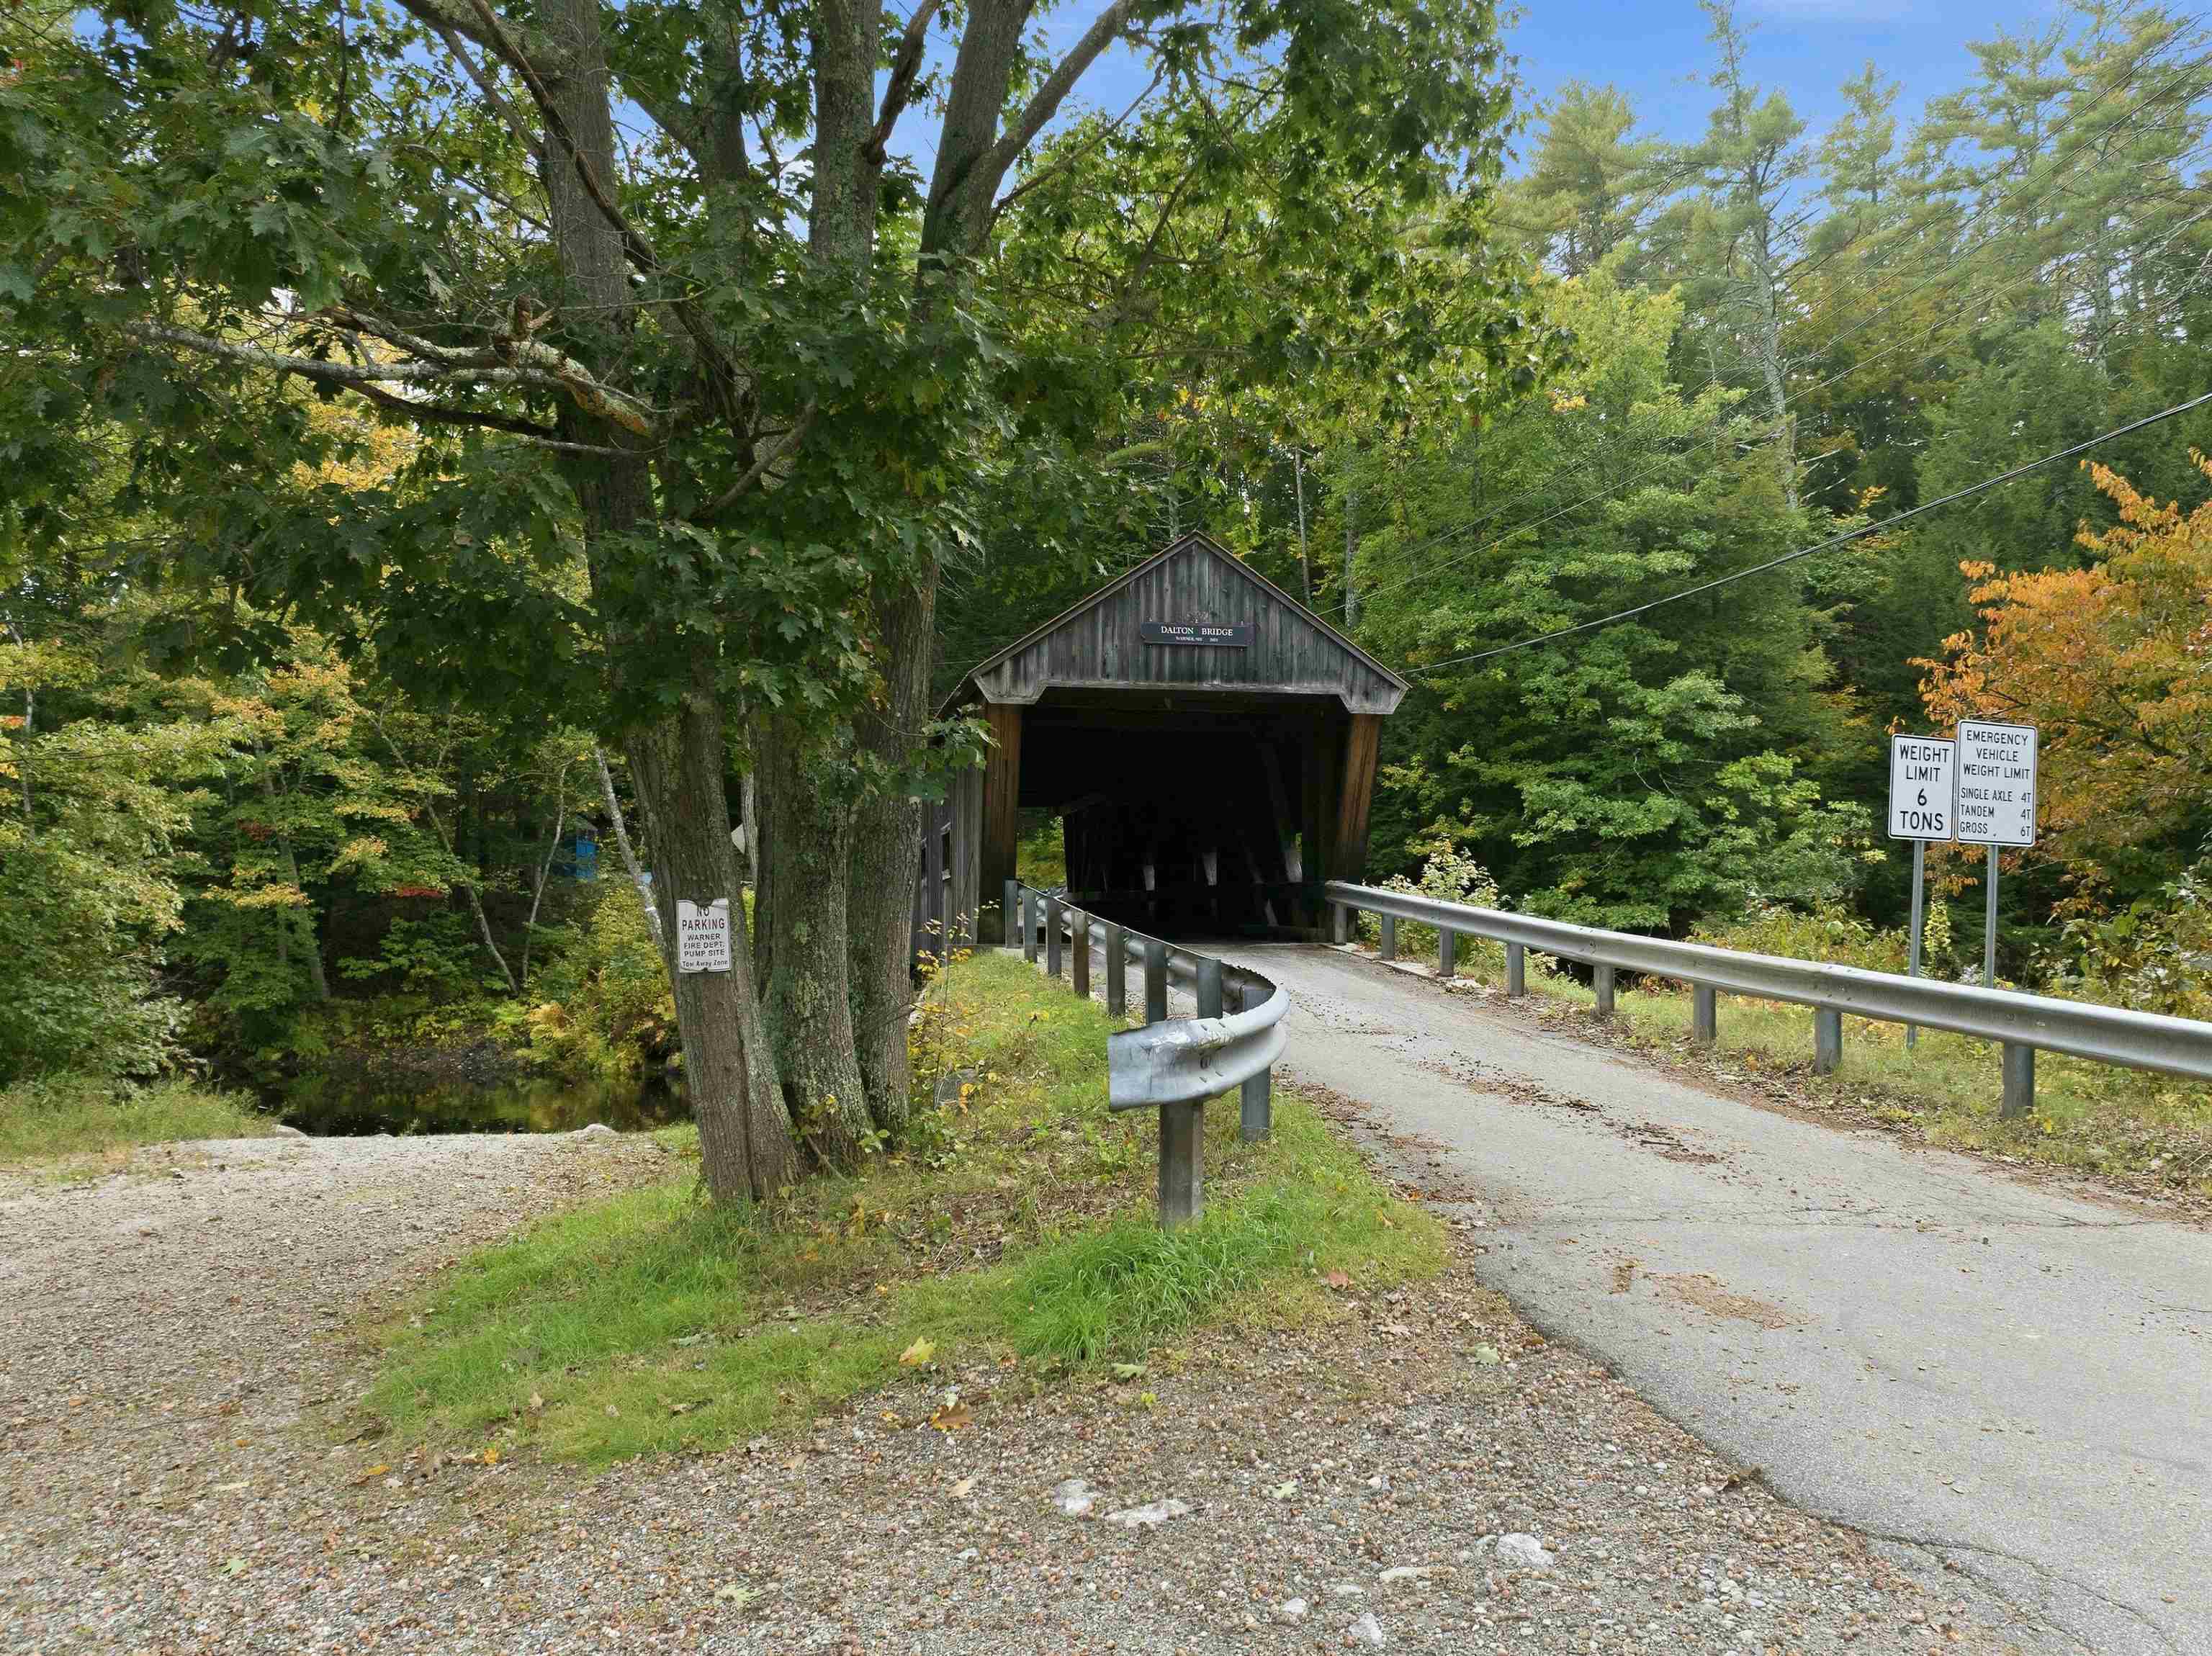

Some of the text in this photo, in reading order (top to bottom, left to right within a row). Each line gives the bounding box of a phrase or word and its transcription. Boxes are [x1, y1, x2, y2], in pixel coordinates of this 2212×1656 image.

[1161, 626, 1233, 636] DALTON BRIDGE
[1966, 729, 2028, 746] EMERGENCY
[1899, 744, 1949, 762] WEIGHT
[1976, 748, 2018, 762] VEHICLE
[1906, 765, 1941, 782] LIMIT
[1964, 763, 2031, 780] WEIGHT LIMIT
[1917, 788, 1928, 806] 6
[1961, 788, 2031, 803] SINGLE AXLE 4T
[1961, 804, 2031, 819] TANDEM 4T
[1899, 811, 1943, 831] TONS
[1960, 822, 2031, 837] GROSS 6T
[696, 906, 709, 917] NO
[682, 918, 725, 930] PARKING
